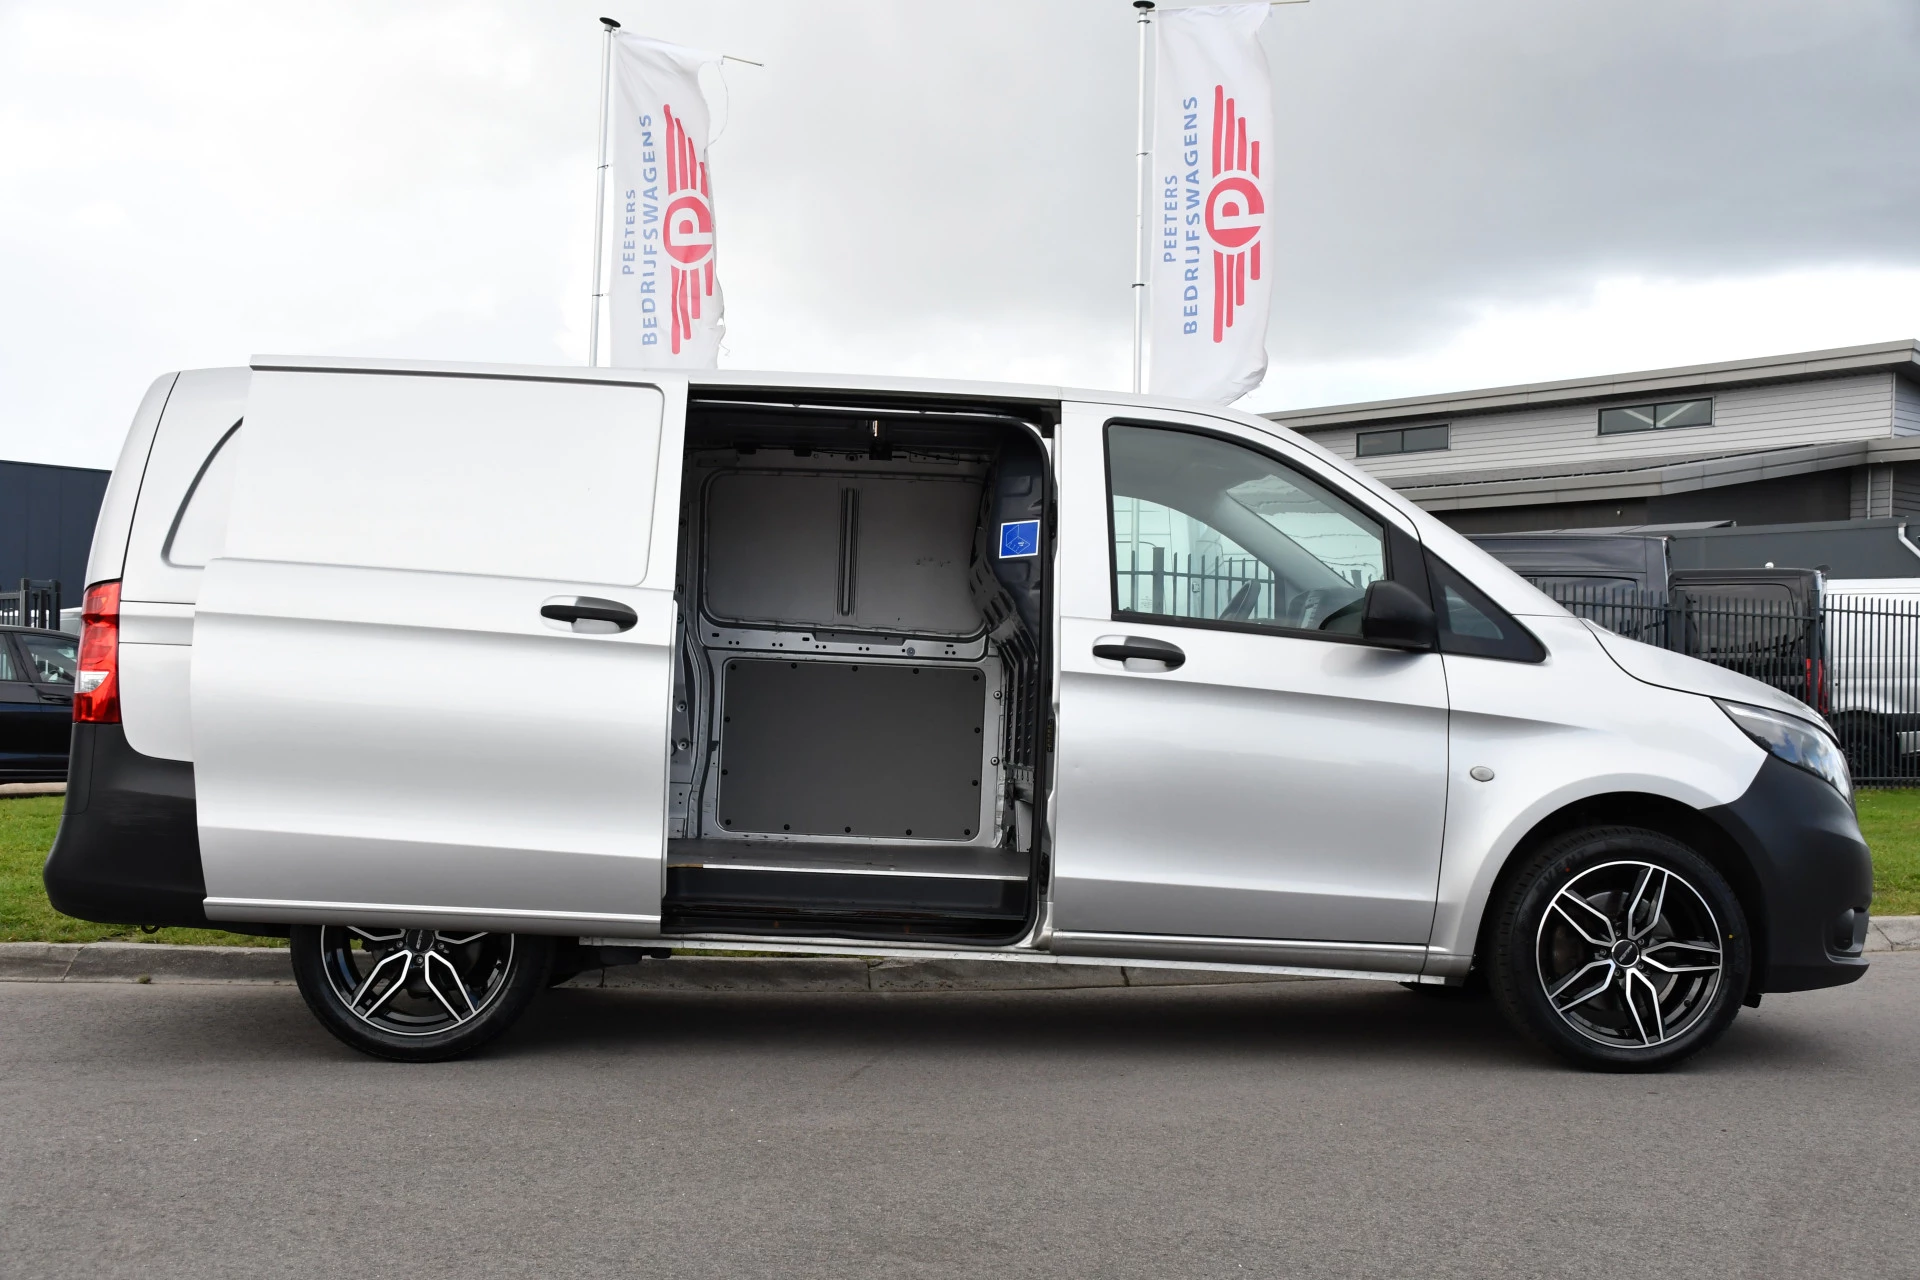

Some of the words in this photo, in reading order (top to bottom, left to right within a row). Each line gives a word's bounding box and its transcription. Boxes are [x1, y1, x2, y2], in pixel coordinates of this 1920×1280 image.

[622, 189, 635, 275] PEETERS
[639, 114, 658, 345] BEDRIJFSWAGENS
[1163, 174, 1178, 263] PEETERS
[1183, 96, 1200, 334] BEDRIJFSWAGENS
